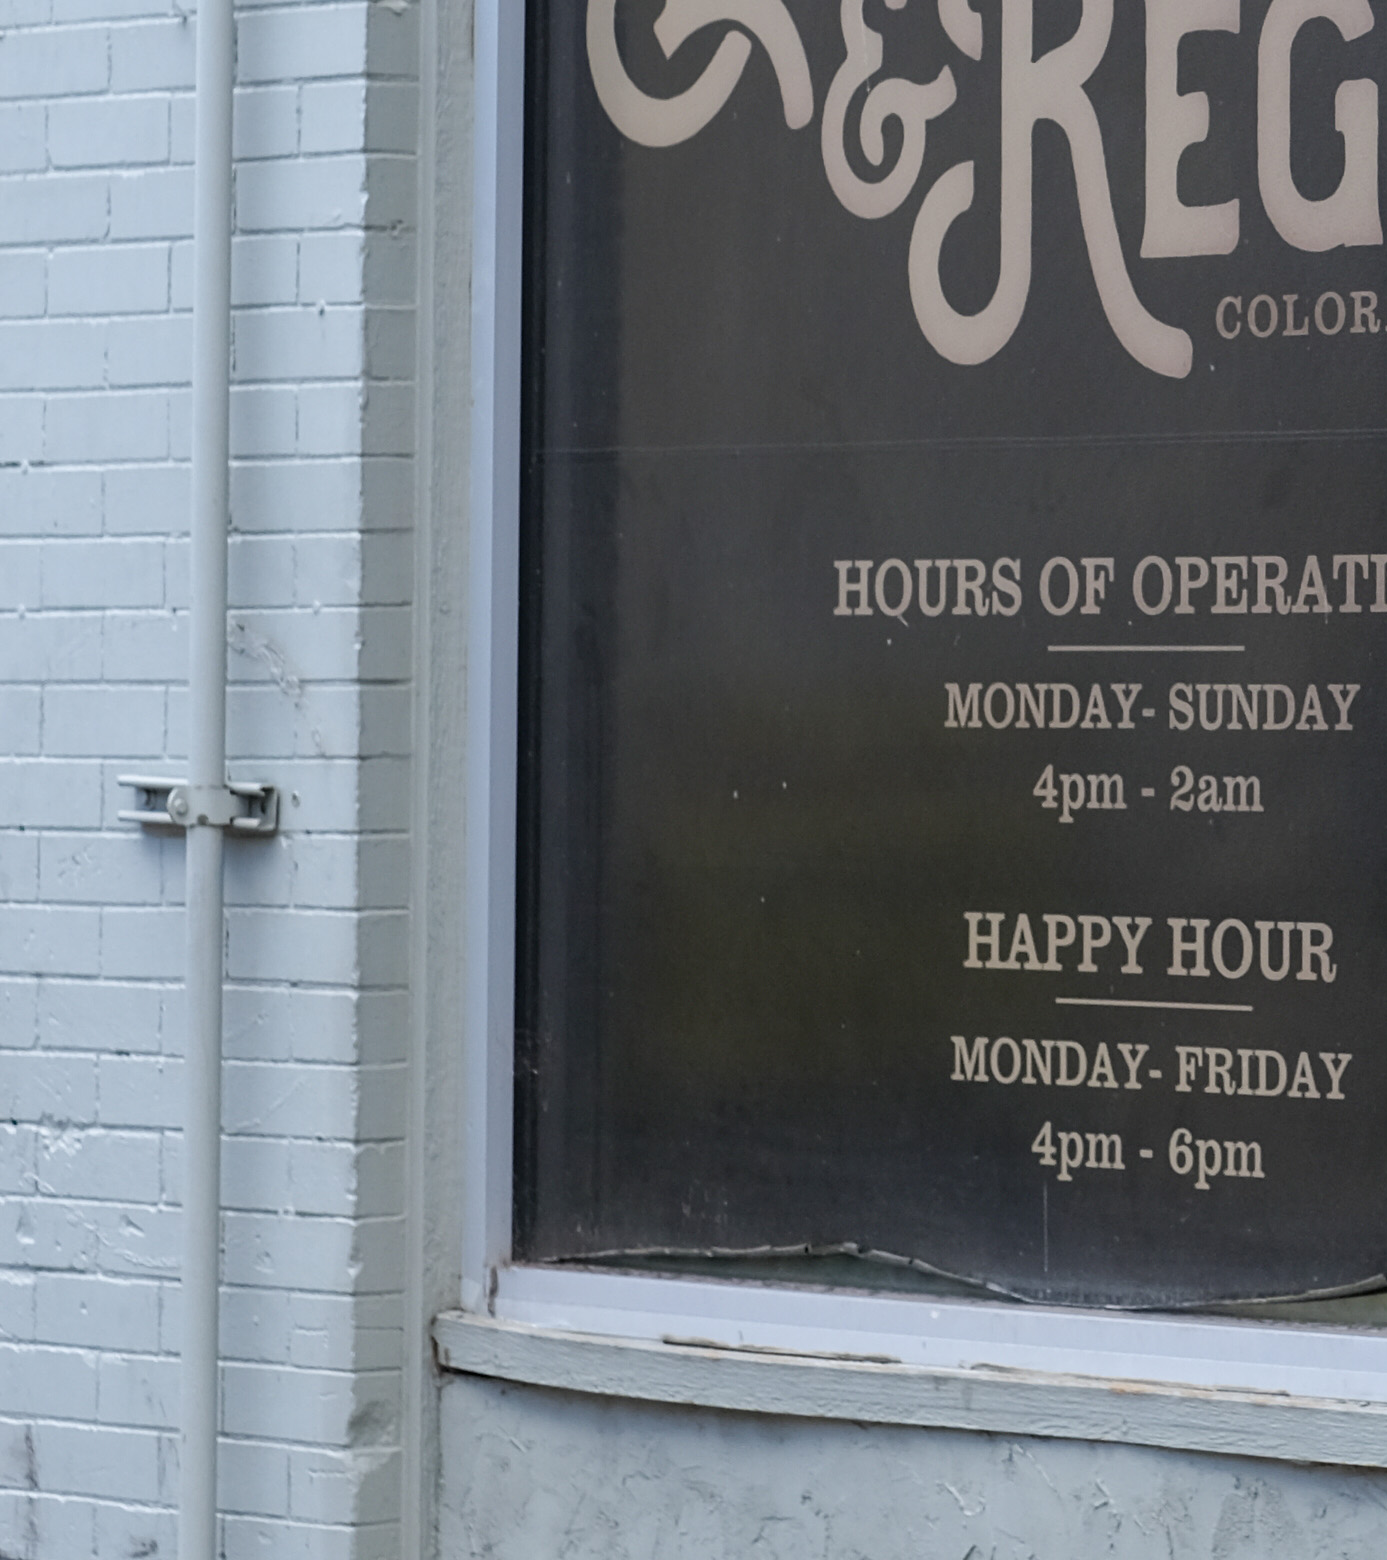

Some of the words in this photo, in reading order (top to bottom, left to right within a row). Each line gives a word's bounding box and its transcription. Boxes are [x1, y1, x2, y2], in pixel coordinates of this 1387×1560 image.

[833, 558, 1023, 617] HOURS
[1039, 557, 1115, 616] OF
[1168, 683, 1361, 731] SUNDAY
[1033, 764, 1128, 823] 4pm
[1170, 766, 1265, 813] 2am
[963, 911, 1152, 974] HAPPY
[1167, 918, 1338, 983] HOUR
[1175, 1046, 1353, 1100] FRIDAY
[1031, 1121, 1126, 1181] 4pm
[1168, 1128, 1266, 1190] 6pm
